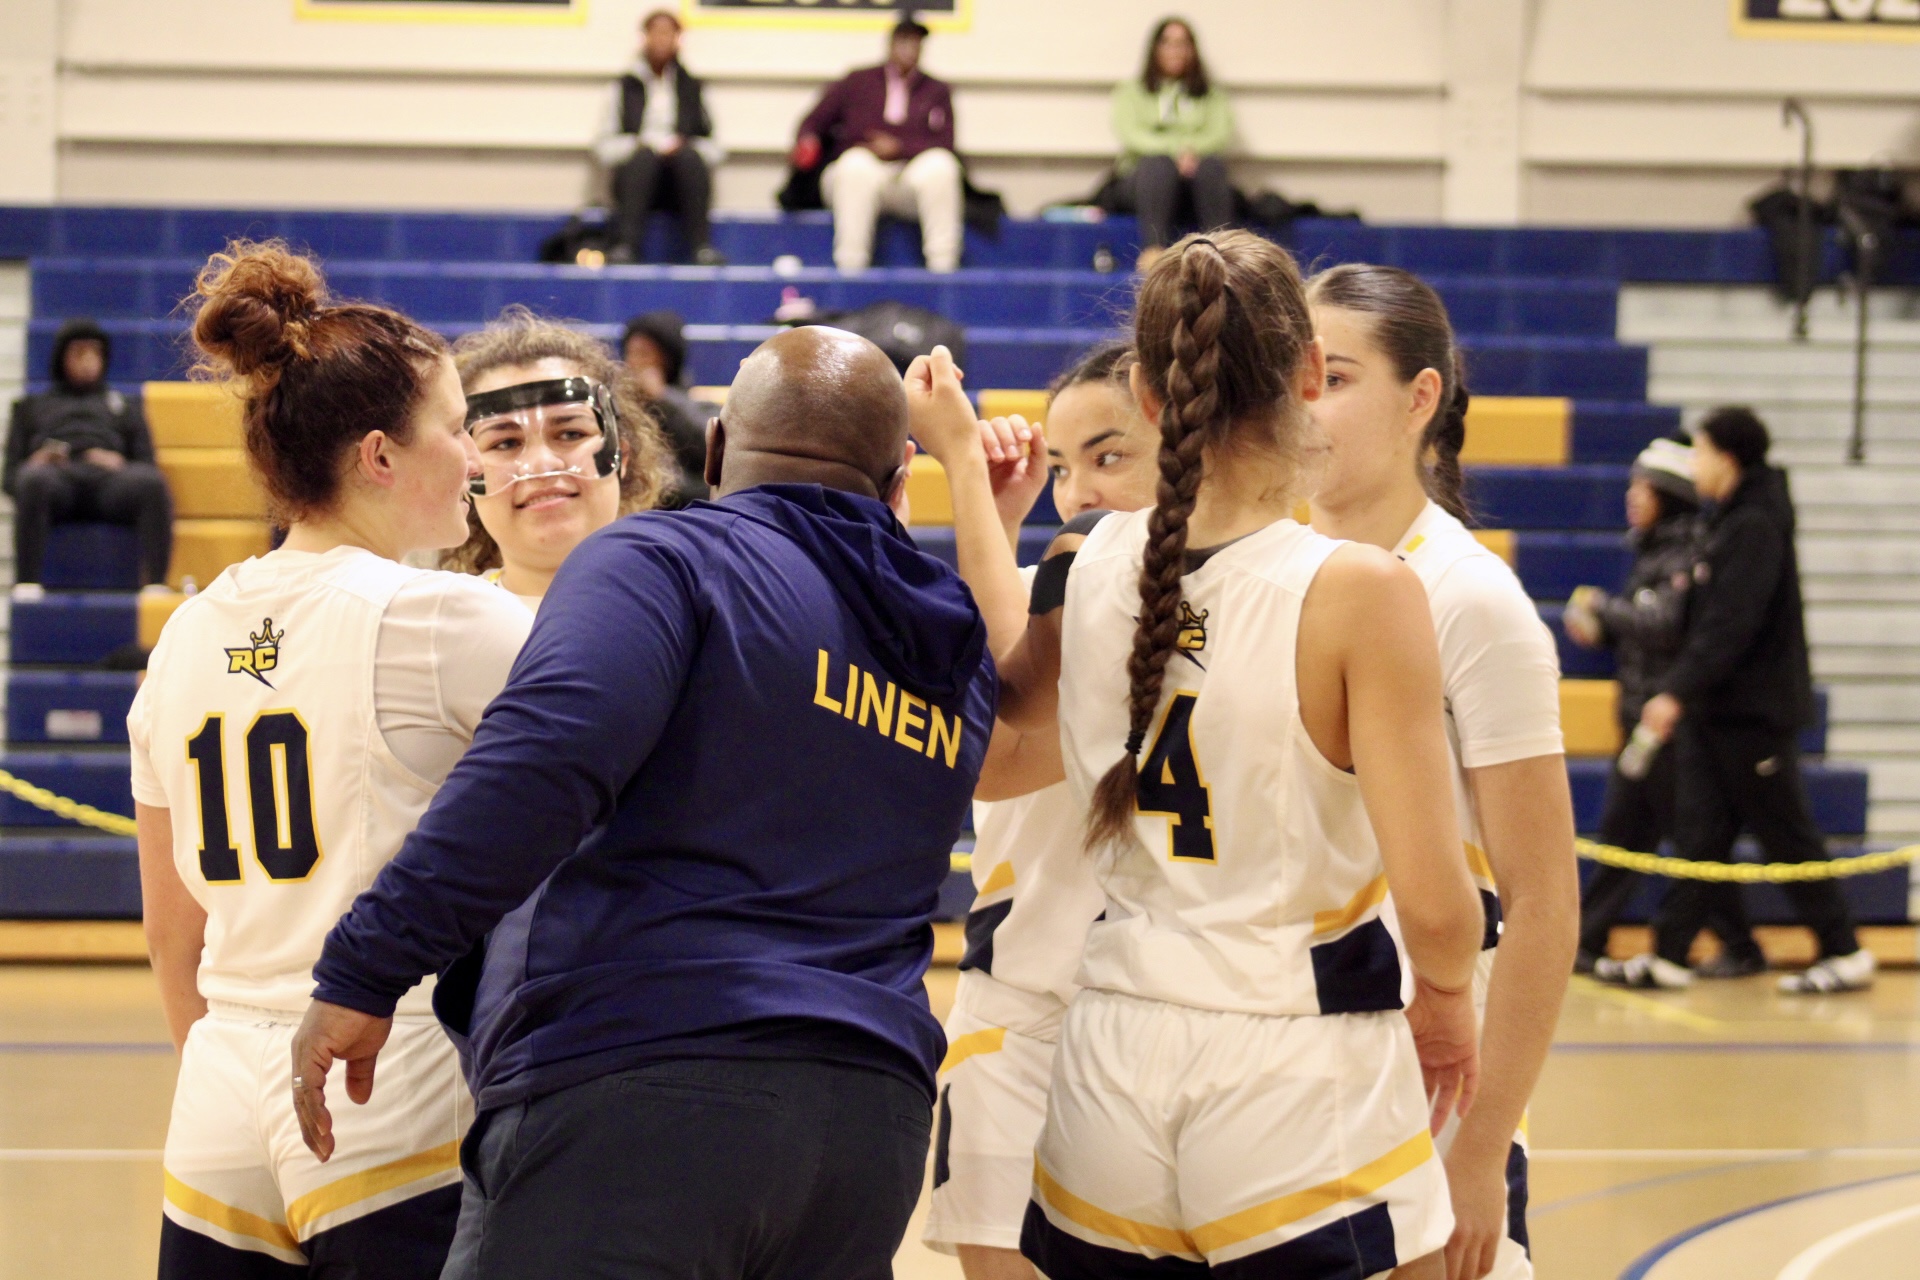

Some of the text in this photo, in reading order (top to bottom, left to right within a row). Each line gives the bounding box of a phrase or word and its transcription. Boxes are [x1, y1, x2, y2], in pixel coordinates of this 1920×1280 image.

[224, 646, 281, 690] RC
[813, 648, 962, 769] LINEN
[185, 707, 324, 886] 10
[1134, 688, 1218, 866] 4
